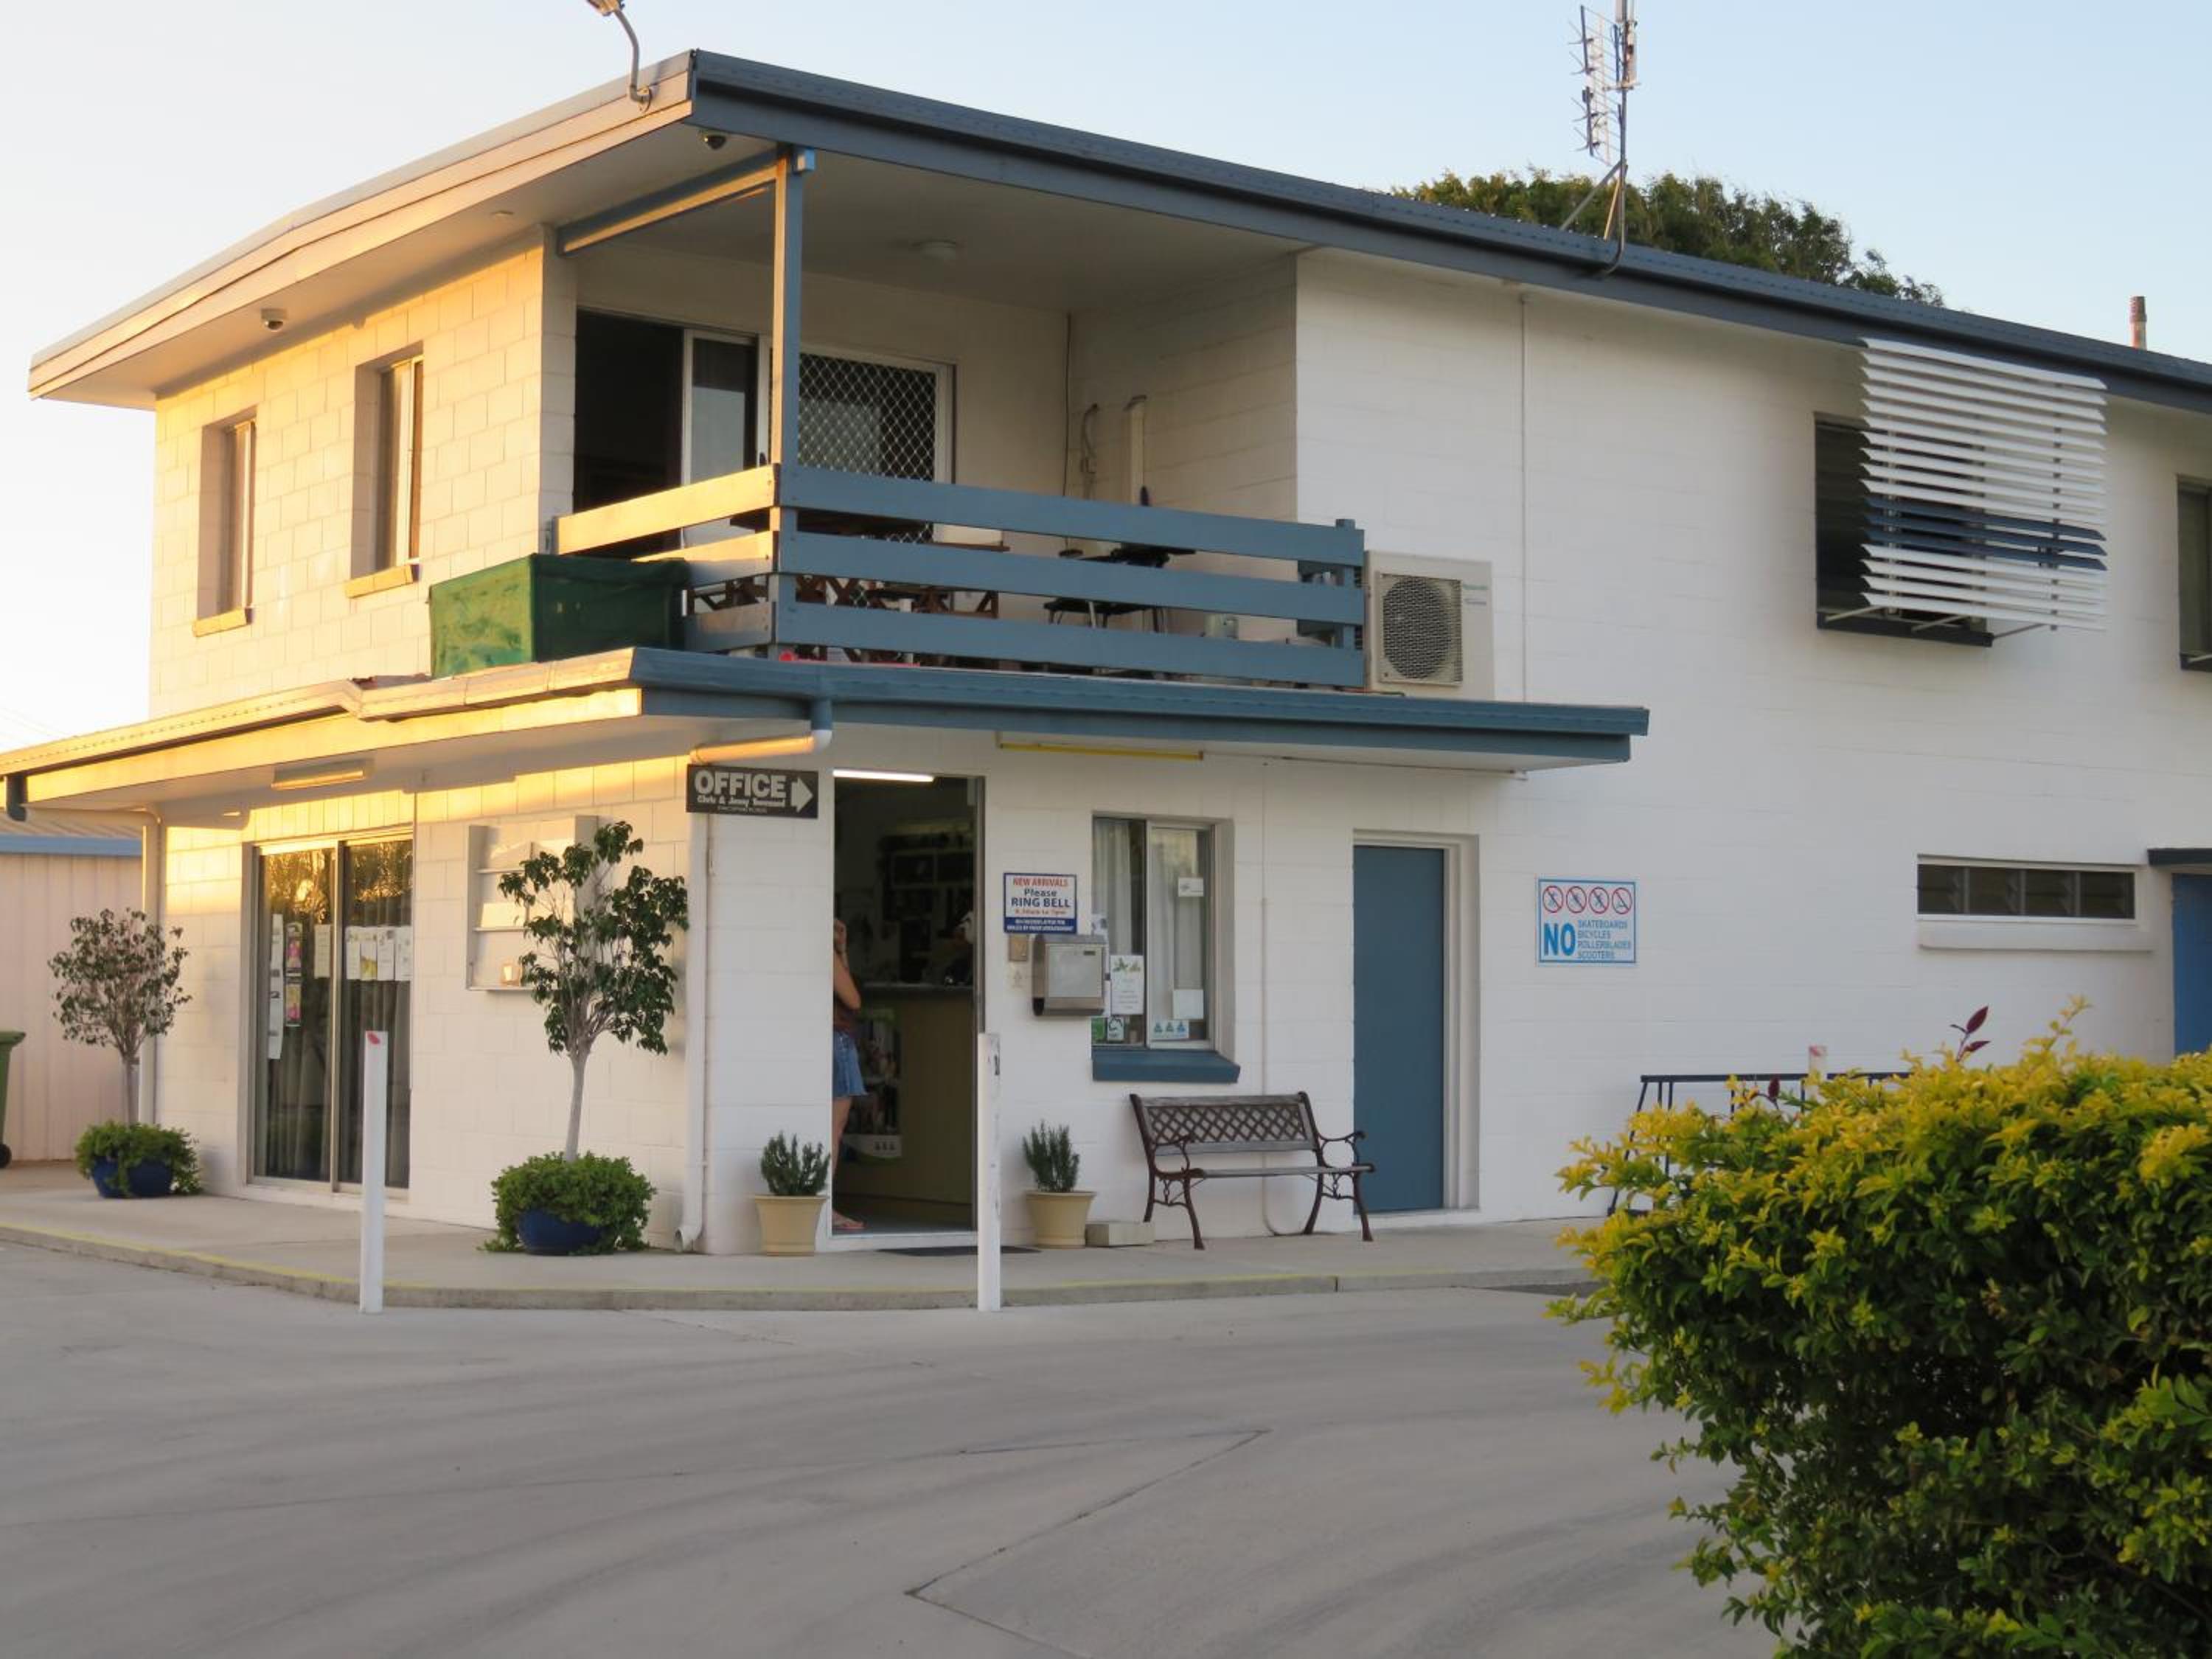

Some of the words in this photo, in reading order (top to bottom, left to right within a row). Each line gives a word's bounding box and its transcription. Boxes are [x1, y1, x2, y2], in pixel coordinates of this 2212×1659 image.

[695, 770, 787, 799] OFFICE
[1013, 877, 1032, 886] NEW
[1032, 877, 1068, 887] ARRIVALS
[1024, 888, 1057, 897] Please
[1011, 897, 1040, 908] RING
[1043, 898, 1071, 908] BELL
[1543, 922, 1576, 956] NO
